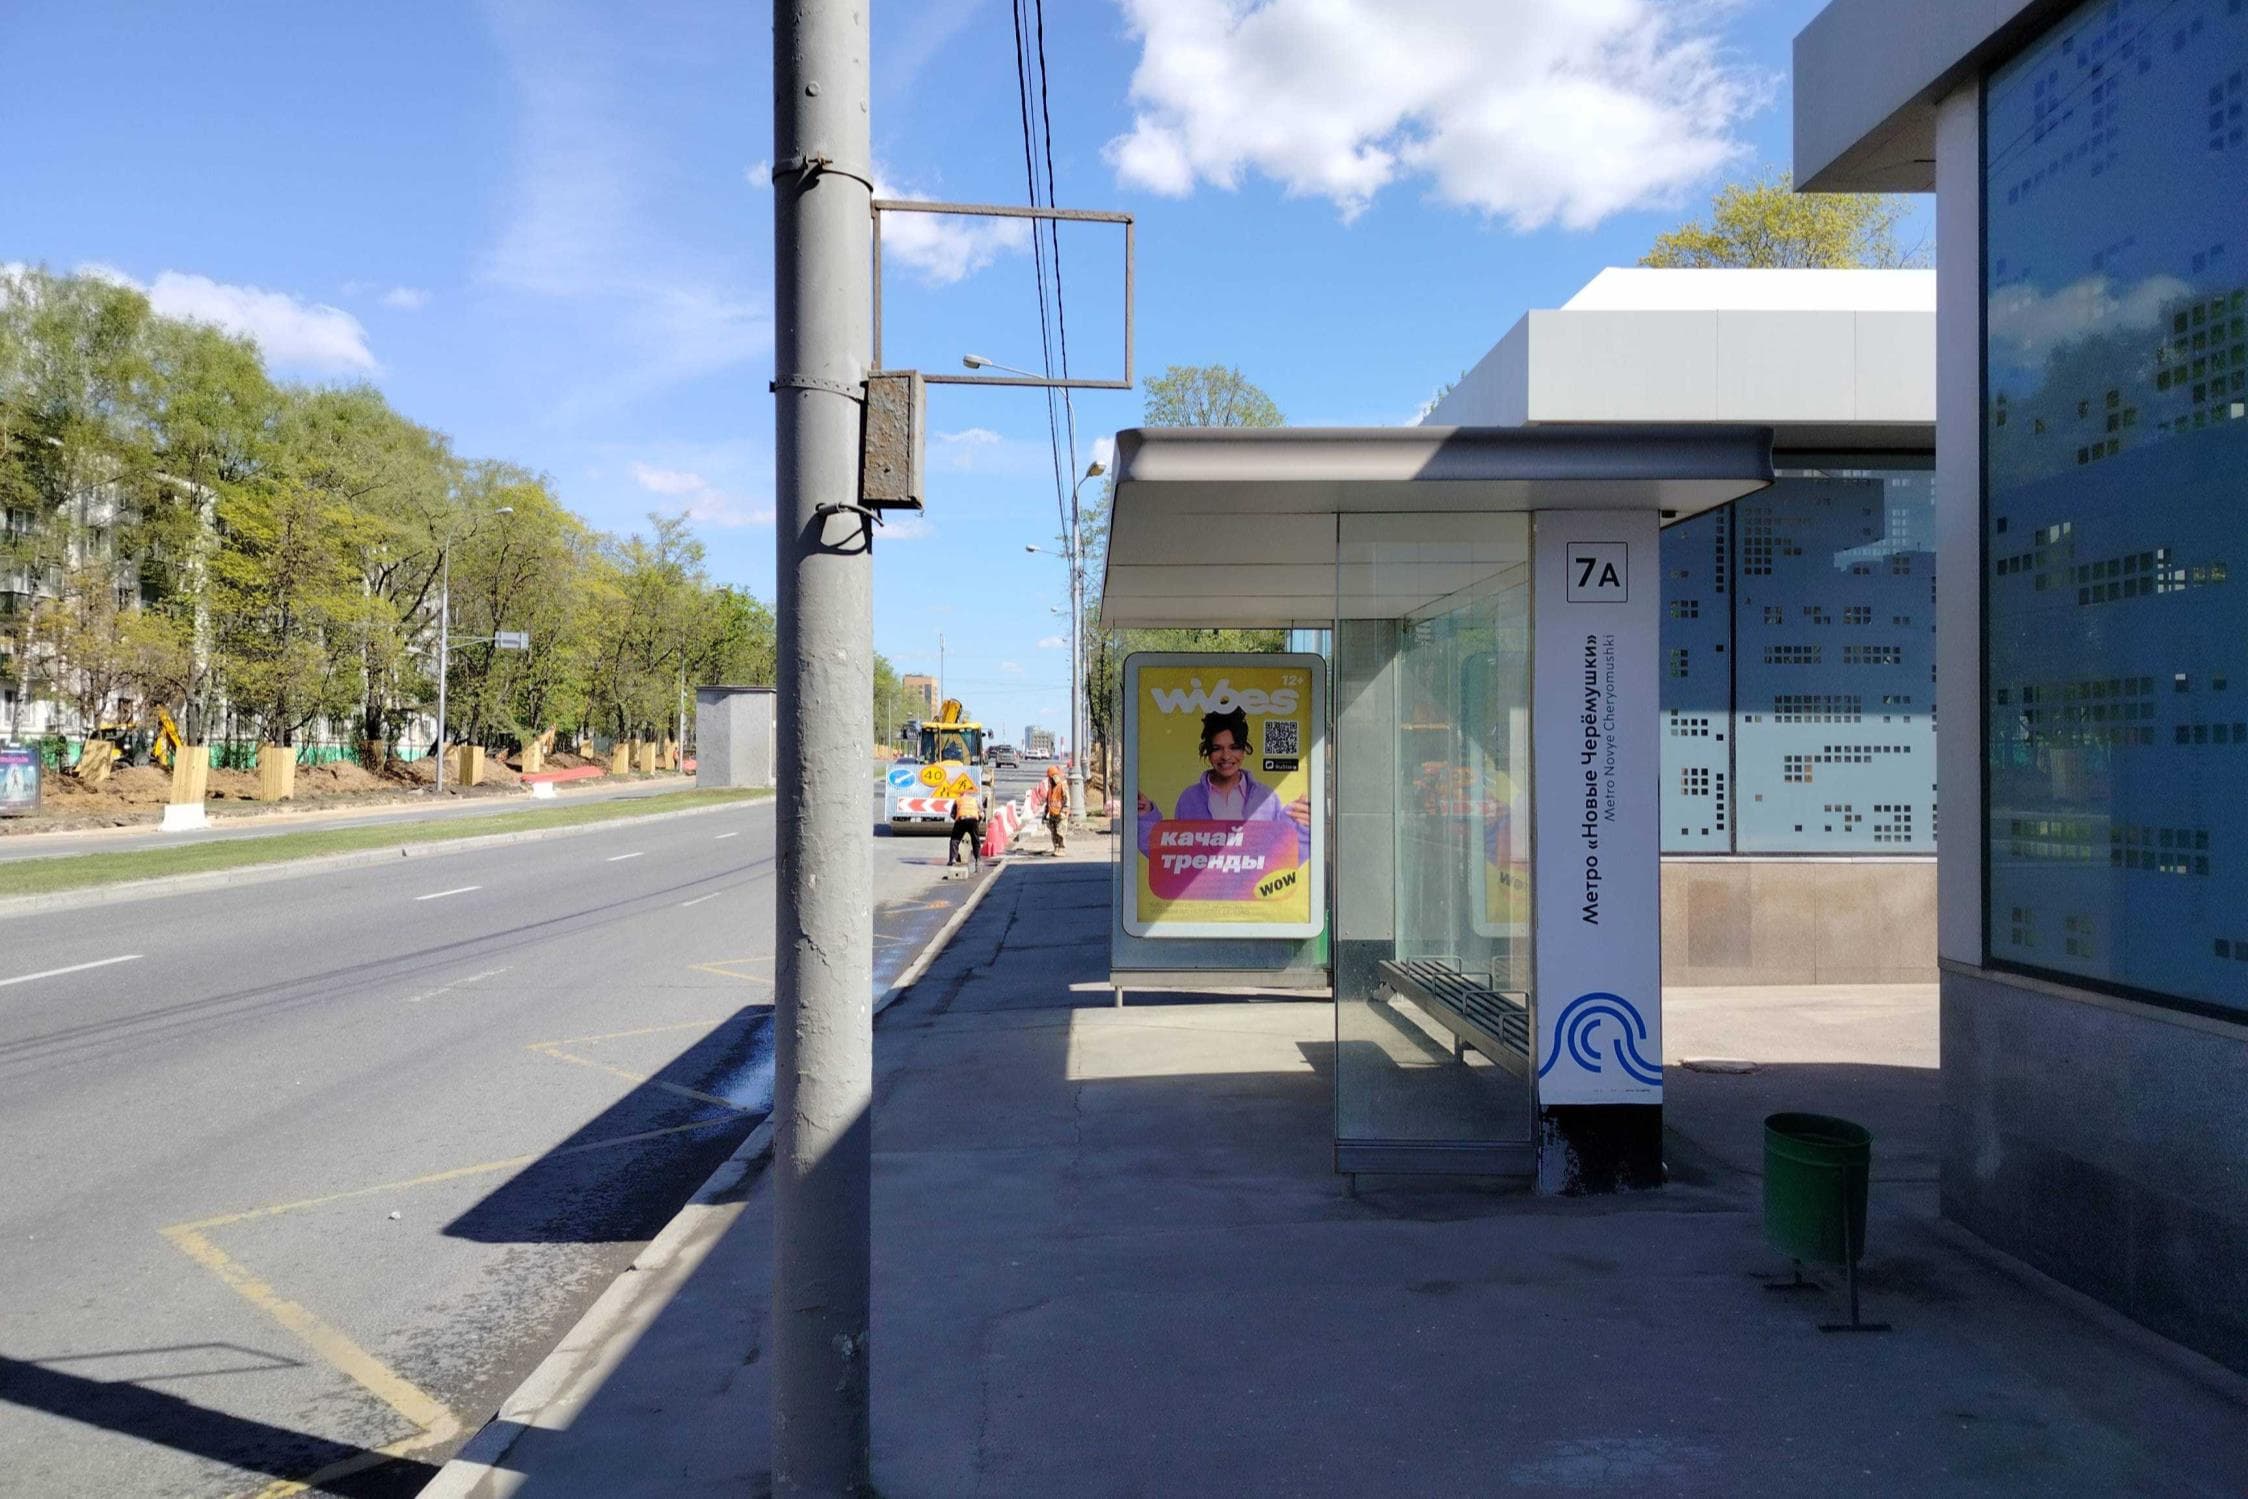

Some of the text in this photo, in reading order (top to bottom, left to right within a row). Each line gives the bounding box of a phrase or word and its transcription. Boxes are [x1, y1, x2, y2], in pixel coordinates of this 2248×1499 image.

[1150, 677, 1300, 715] wibes
[1603, 634, 1617, 822] Metro Novye Cheryomushki
[924, 770, 942, 780] 40
[1581, 634, 1602, 925] Метро «Новые Черёмушки»
[1160, 826, 1244, 847] качай
[1161, 854, 1265, 875] тренды
